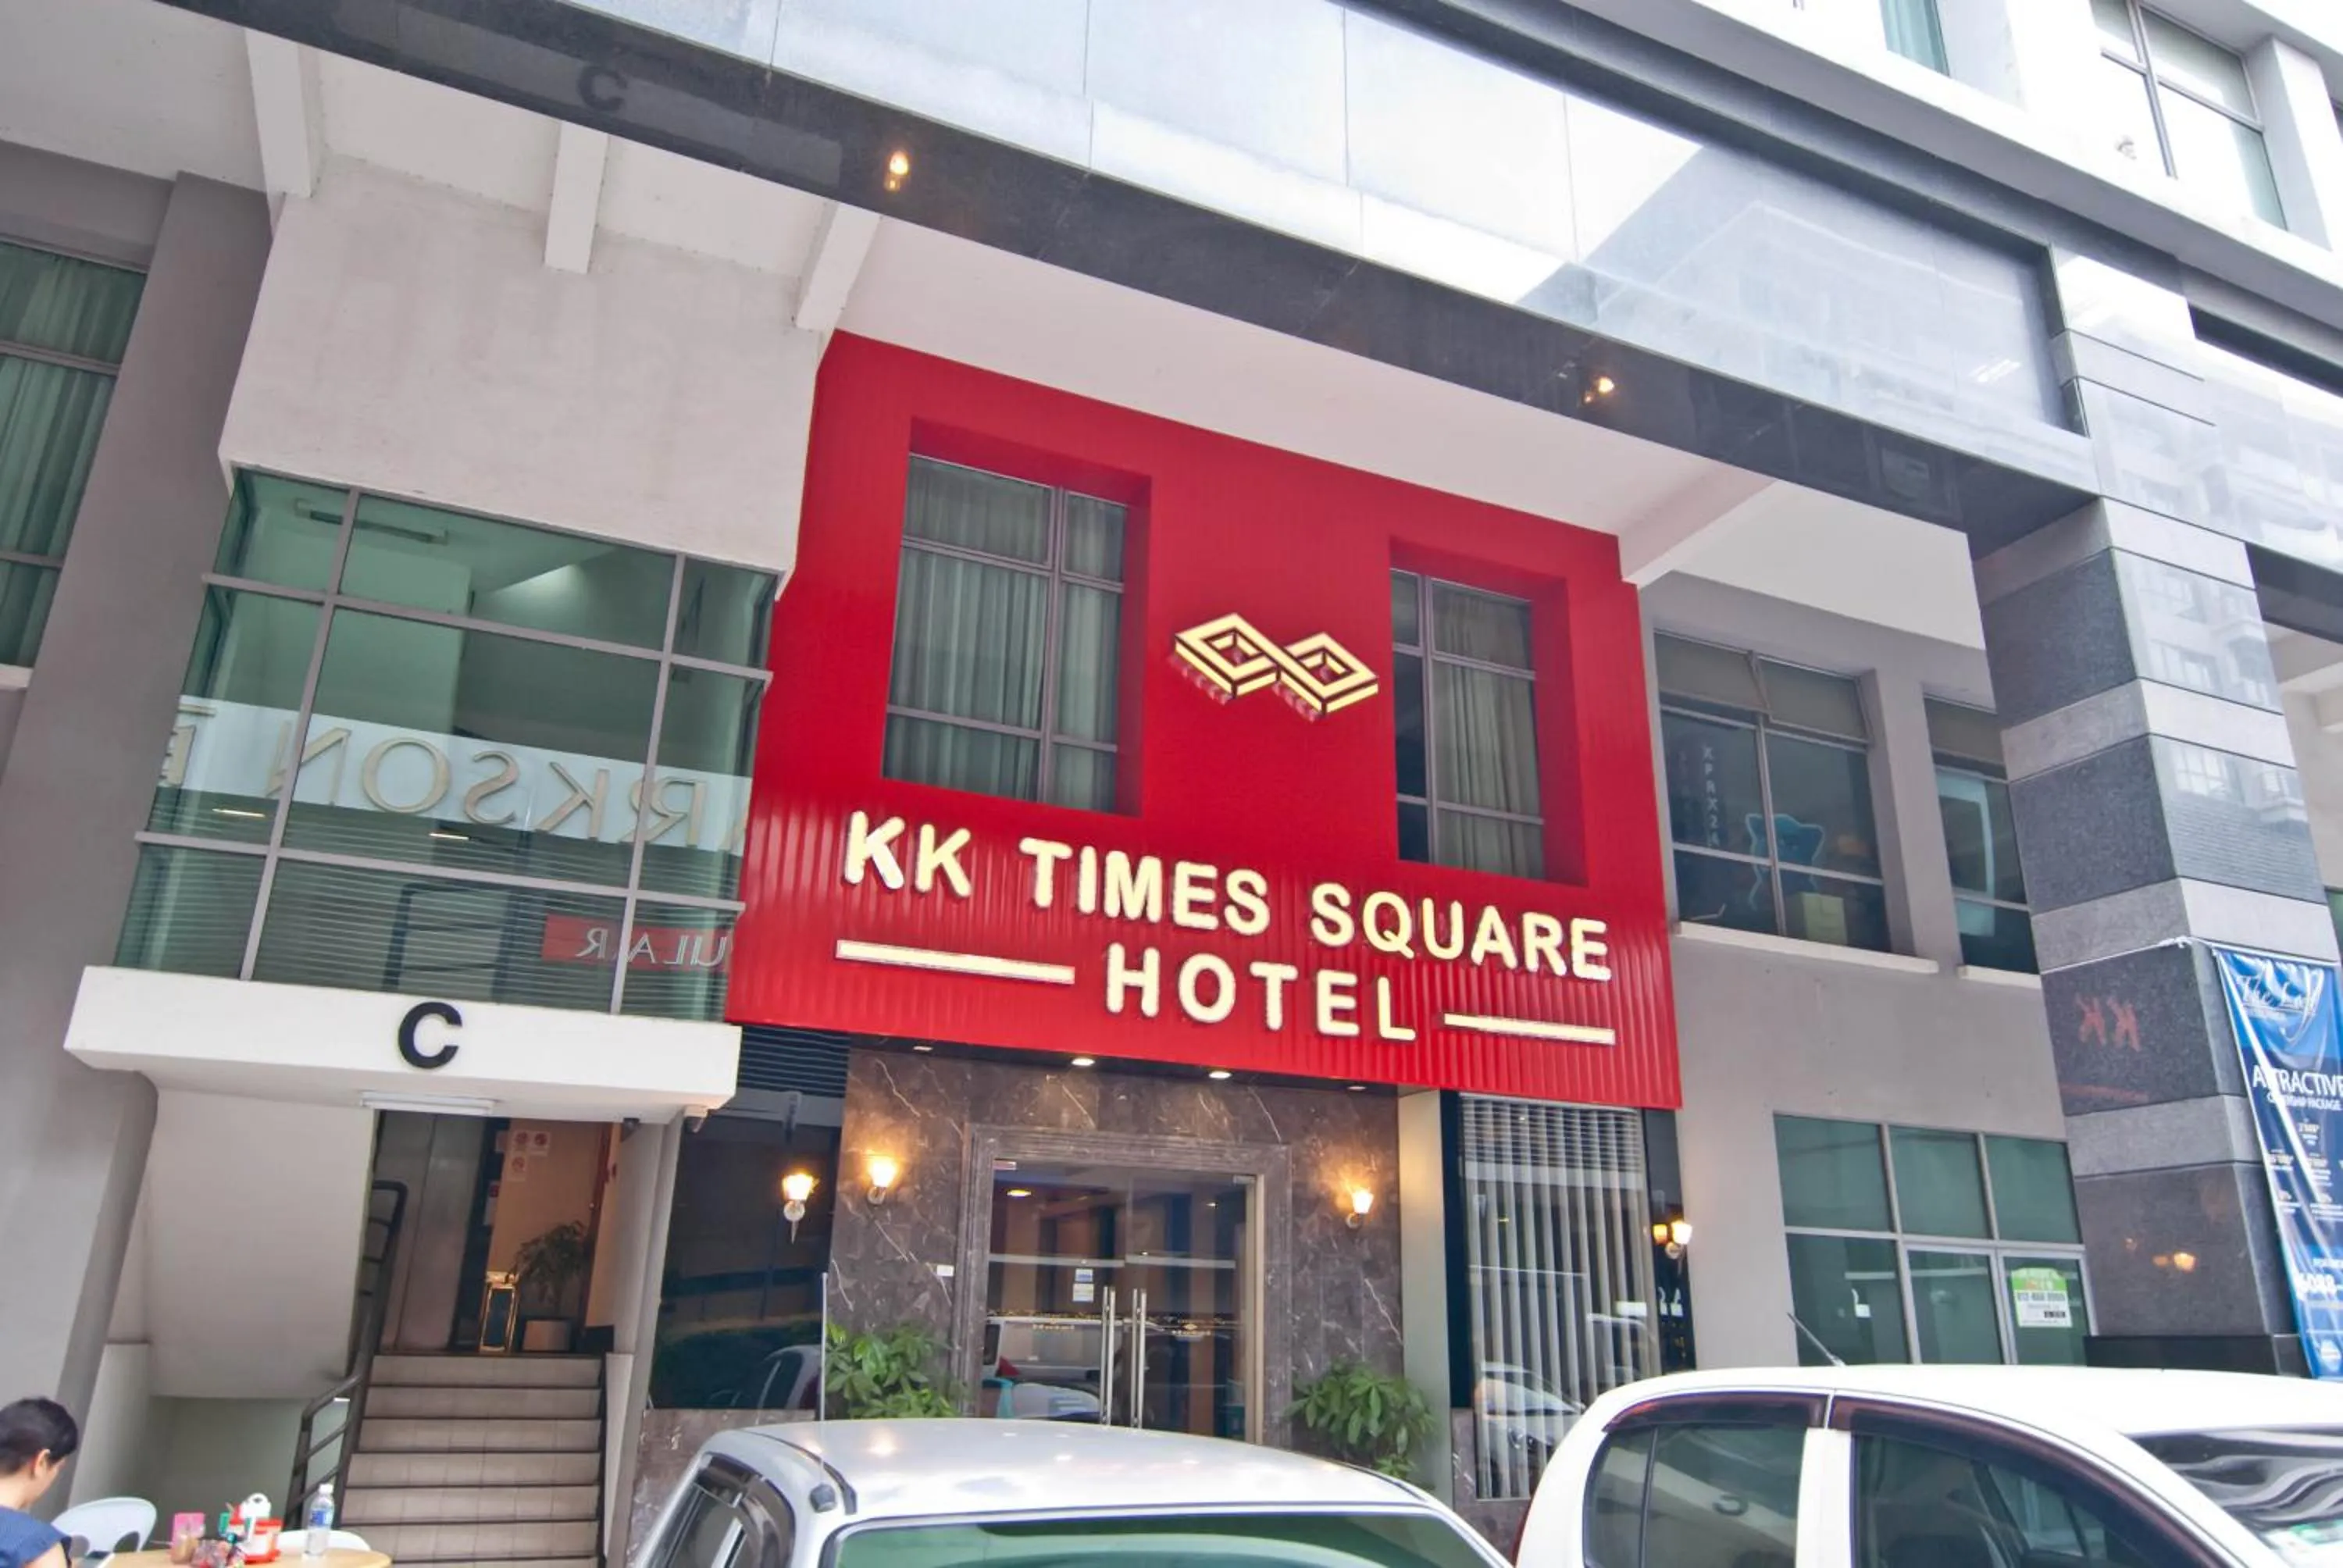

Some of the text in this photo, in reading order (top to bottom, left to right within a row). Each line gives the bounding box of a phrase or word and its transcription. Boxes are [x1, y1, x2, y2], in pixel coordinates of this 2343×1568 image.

[843, 810, 1613, 982] KK TIMES SQUARE
[1106, 942, 1417, 1042] HOTEL
[398, 1001, 462, 1070] C
[2252, 1064, 2343, 1098] ARACTIVE
